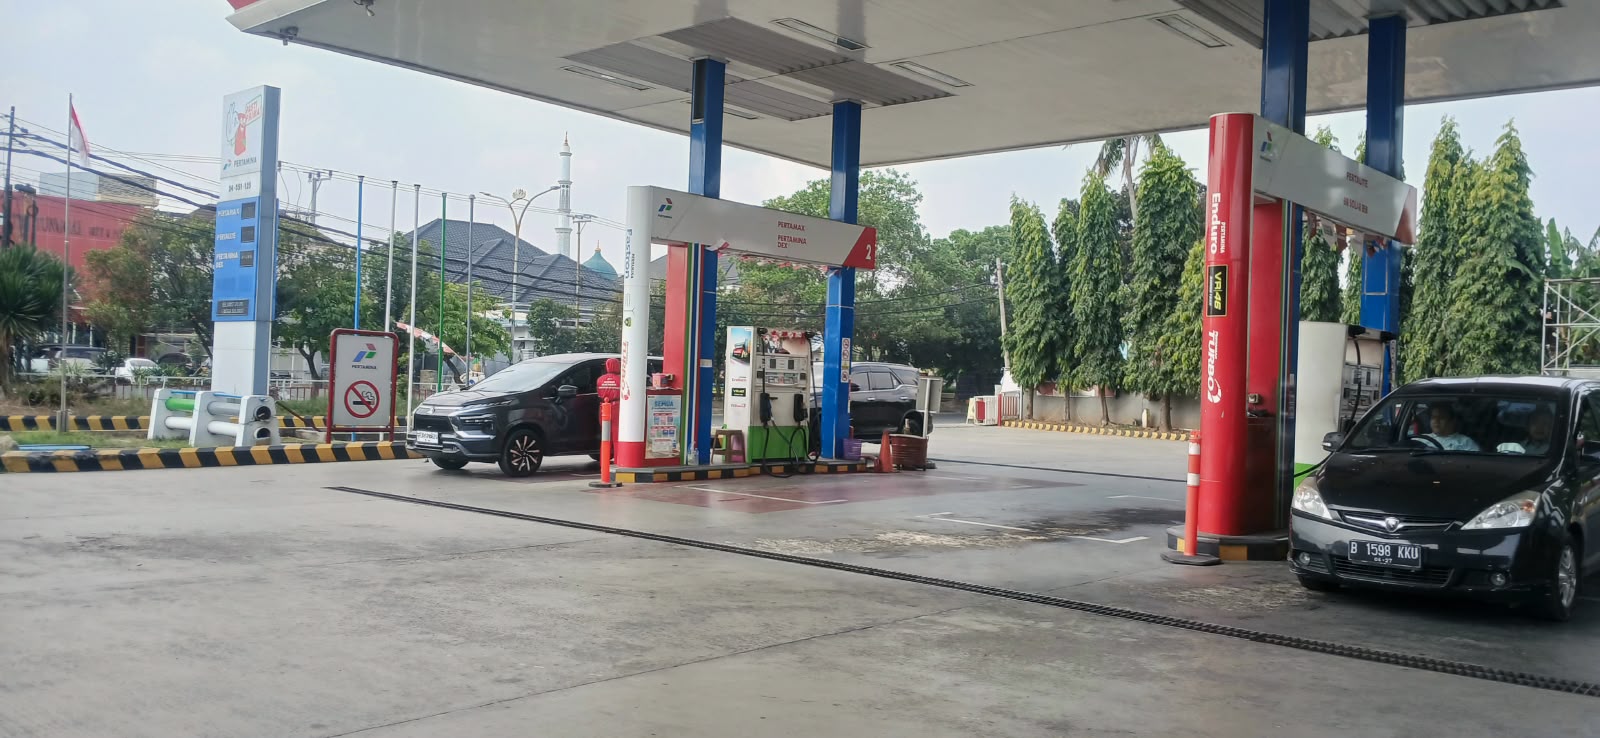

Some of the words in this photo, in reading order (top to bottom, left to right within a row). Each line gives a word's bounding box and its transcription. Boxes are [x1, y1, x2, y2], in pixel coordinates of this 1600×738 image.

[233, 157, 257, 168] PERTAMINA
[777, 221, 805, 231] PERTAMAX
[1210, 192, 1221, 254] Enduro
[777, 234, 807, 245] PERTAMINA
[777, 241, 788, 249] DEX
[625, 229, 633, 279] Fastron
[865, 244, 872, 260] 2
[1208, 330, 1216, 392] TURBO
[1350, 541, 1358, 554] B
[1366, 543, 1391, 557] 1598
[1397, 545, 1419, 560] KKU
